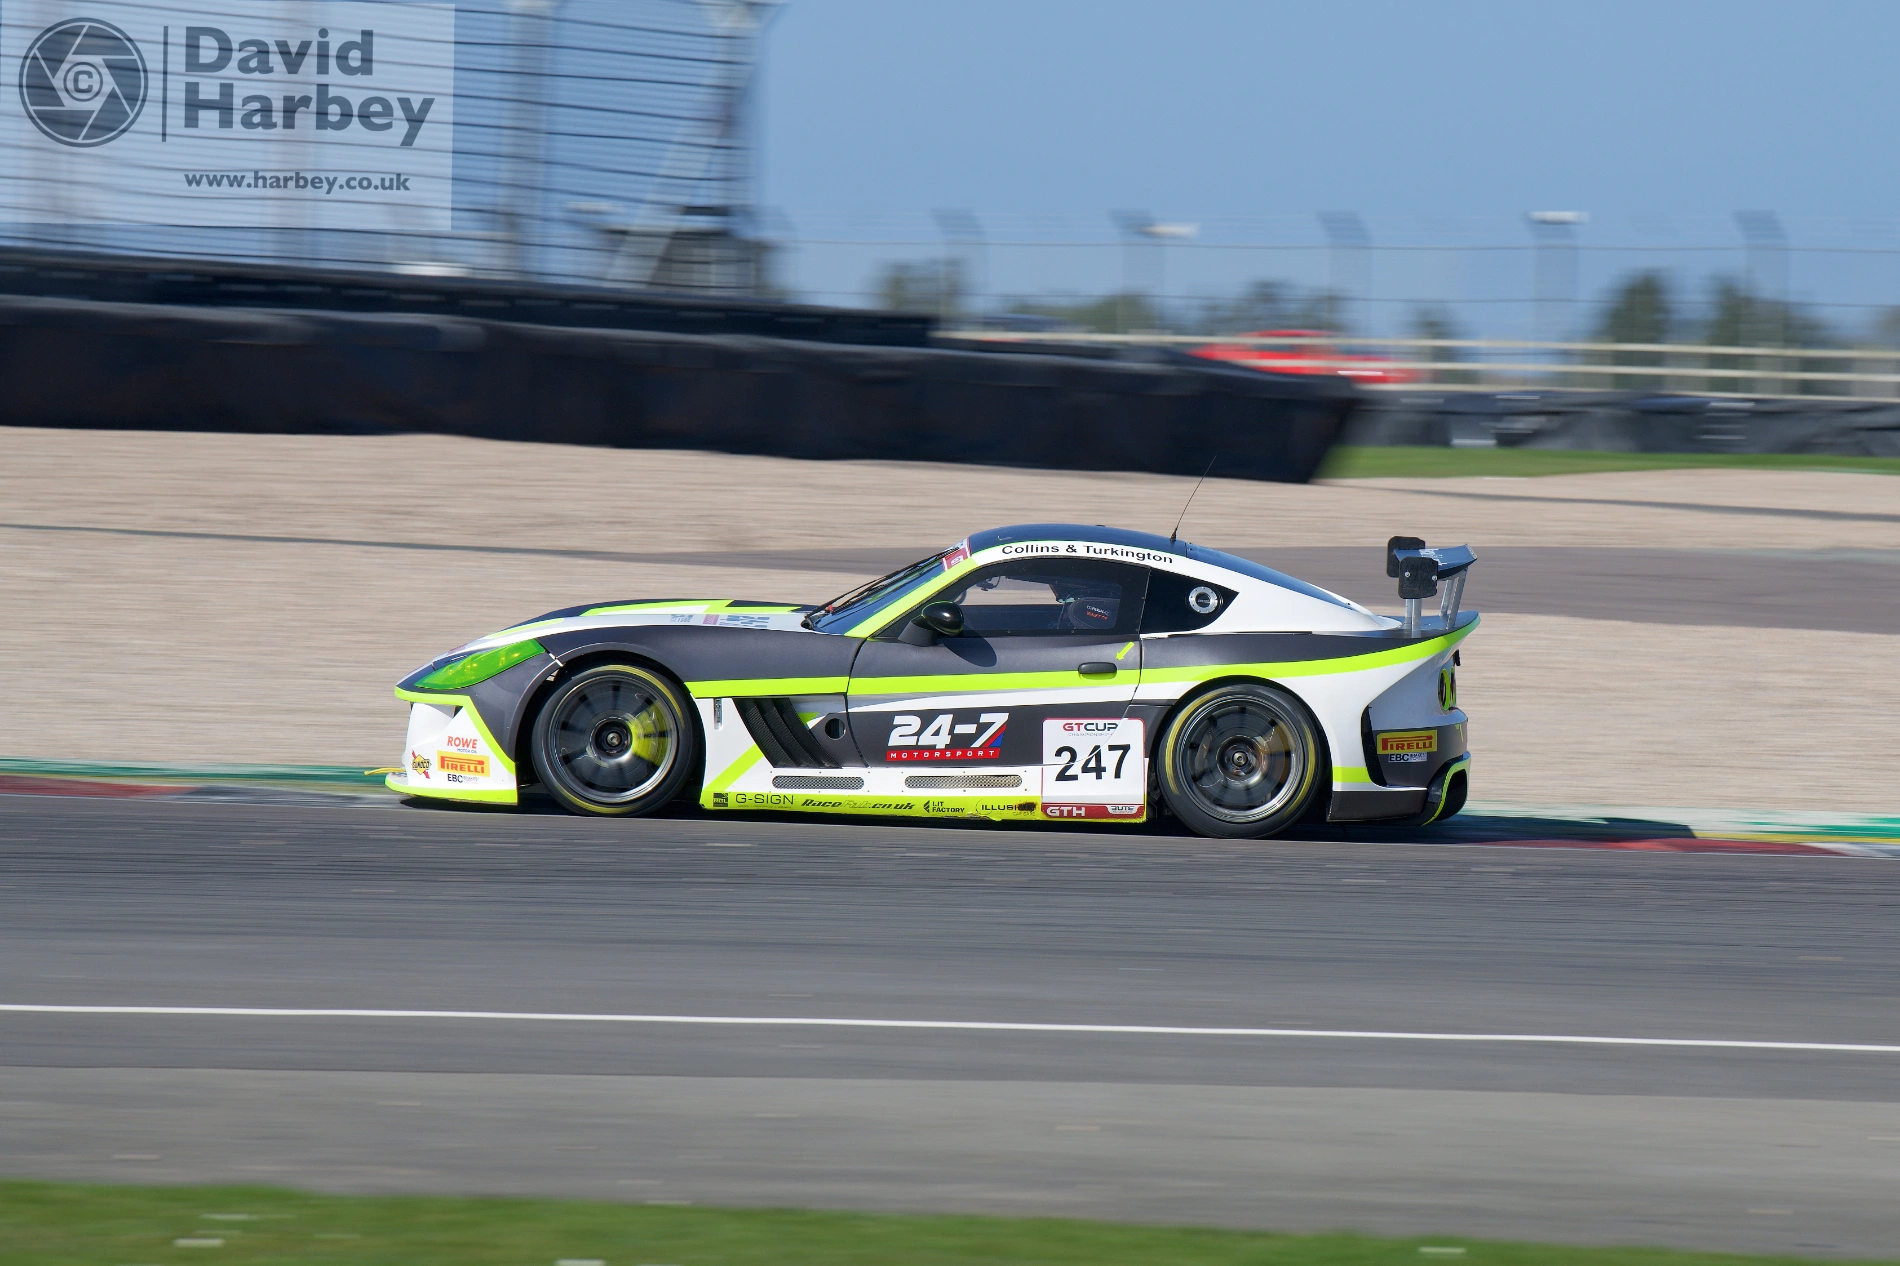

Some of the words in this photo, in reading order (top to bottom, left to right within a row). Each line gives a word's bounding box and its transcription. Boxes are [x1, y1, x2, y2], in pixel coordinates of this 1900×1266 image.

[1001, 544, 1060, 555] Collins
[1065, 544, 1077, 554] &
[1083, 545, 1173, 564] Turkington
[888, 712, 1010, 750] 24-7
[447, 735, 478, 749] ROWE
[1381, 735, 1433, 751] PIRELLI
[890, 750, 995, 759] MOTORSPORT
[1389, 753, 1409, 762] EBC
[440, 755, 485, 774] PIRELLI
[1054, 743, 1131, 782] 247
[447, 773, 464, 783] EBC
[735, 793, 794, 805] G-SIGN
[981, 803, 1036, 812] ILLUSI
[1046, 806, 1086, 817] GTH
